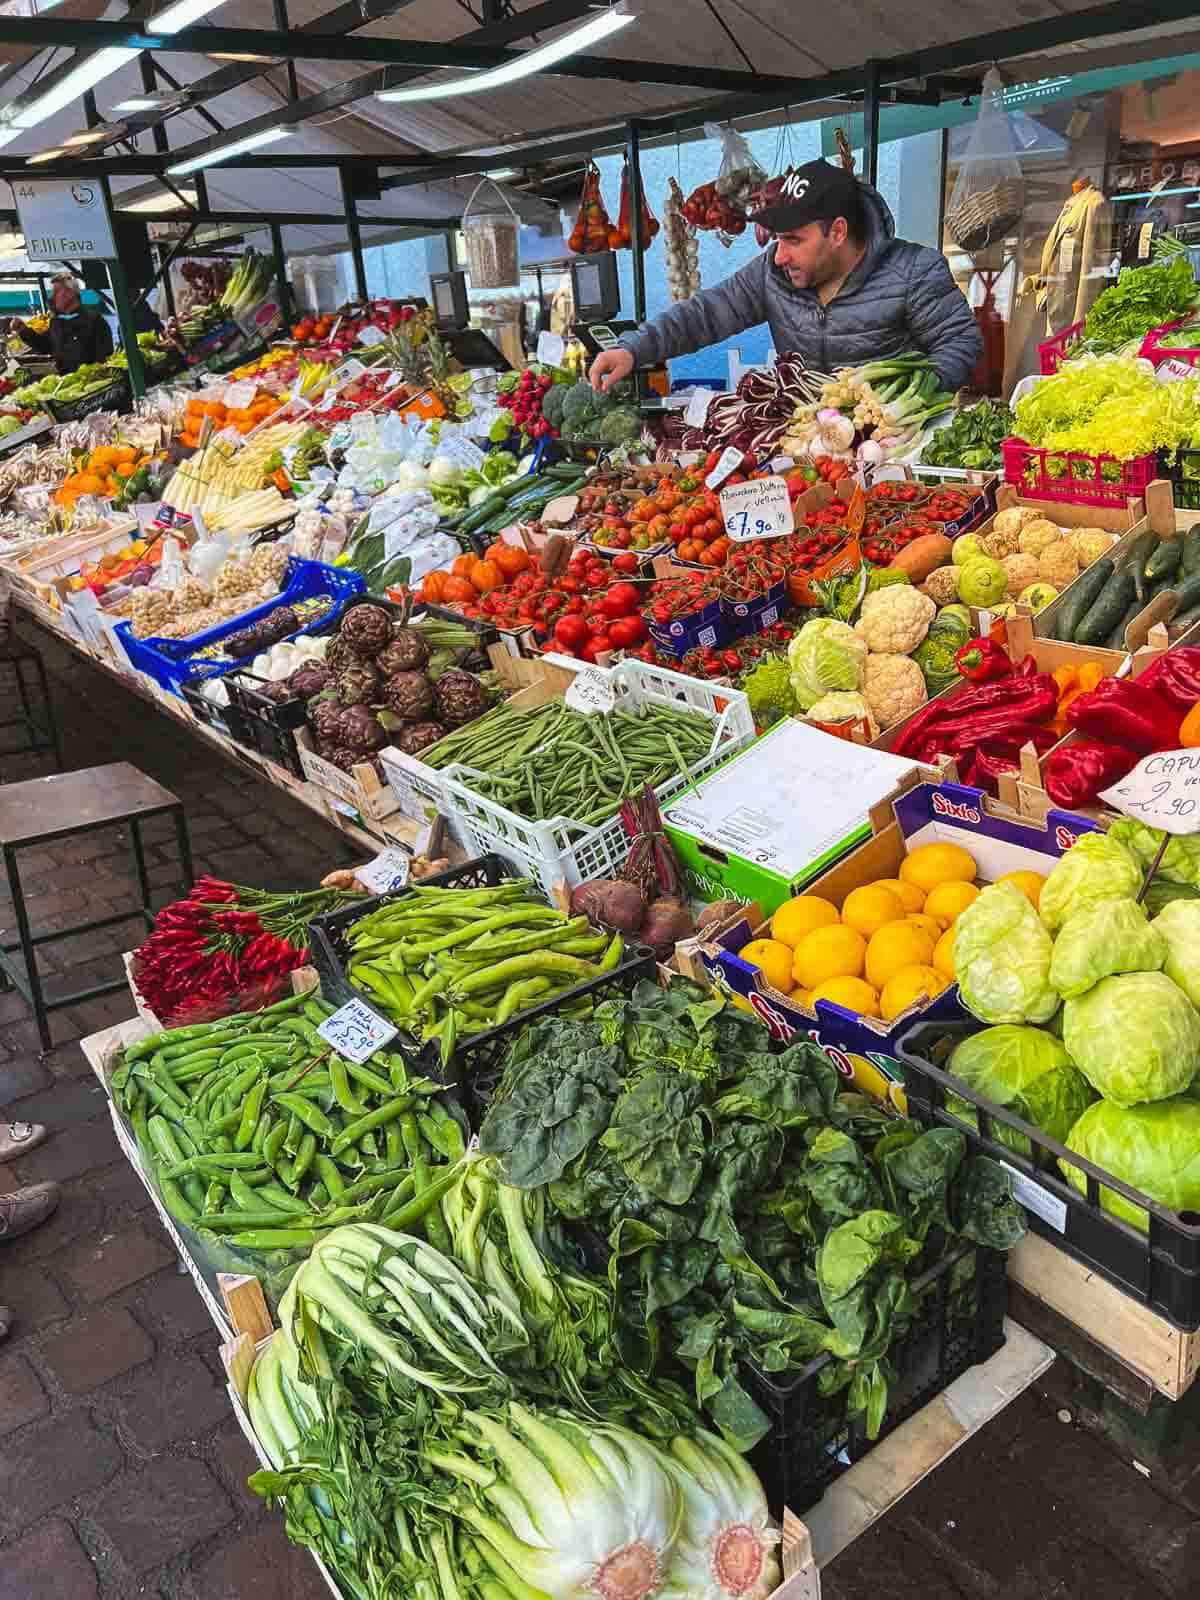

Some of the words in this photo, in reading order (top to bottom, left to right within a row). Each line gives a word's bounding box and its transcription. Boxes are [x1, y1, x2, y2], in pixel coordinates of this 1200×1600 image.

[780, 173, 809, 198] NG
[59, 237, 94, 252] Fava
[932, 793, 980, 823] Sixto
